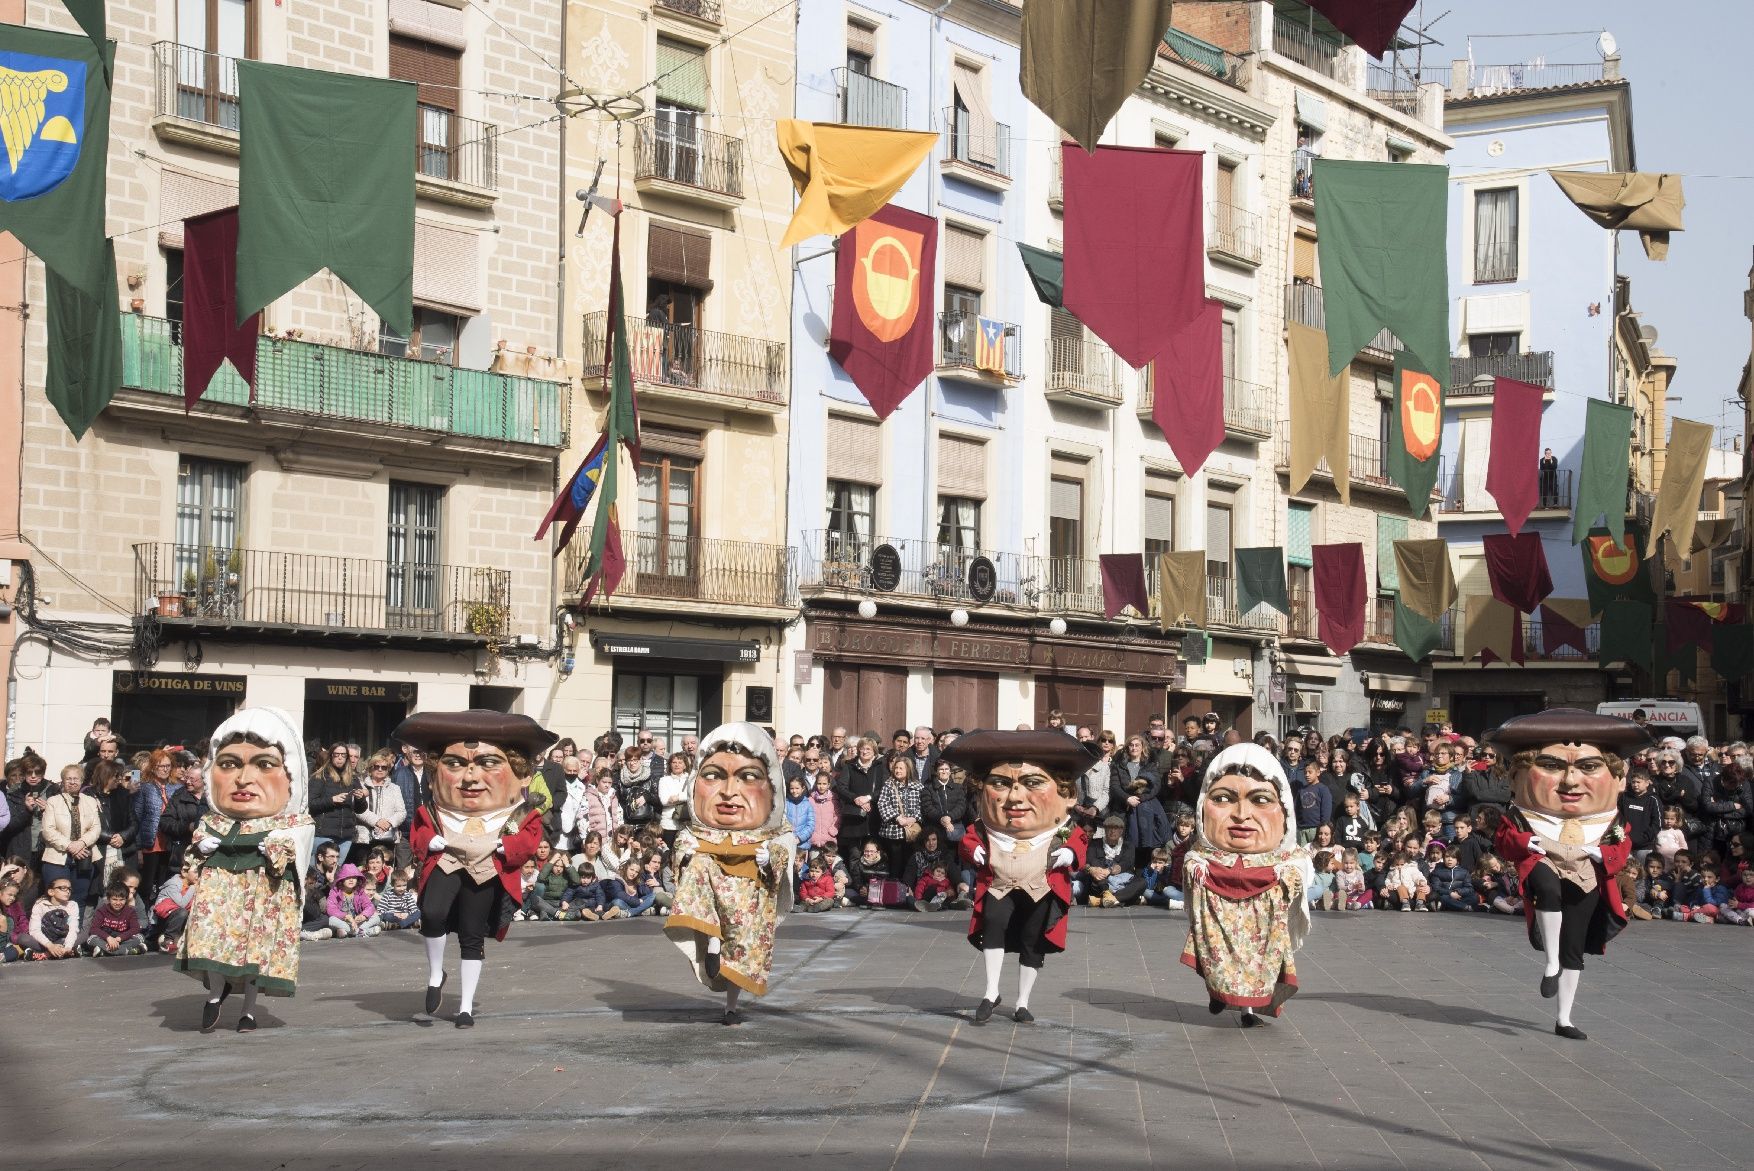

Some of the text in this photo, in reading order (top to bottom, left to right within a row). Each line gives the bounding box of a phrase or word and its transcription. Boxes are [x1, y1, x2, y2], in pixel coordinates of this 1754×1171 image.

[610, 645, 634, 653] ESTRELLA
[950, 640, 1012, 661] FERRER
[193, 680, 212, 691] DE
[214, 680, 245, 692] VINS
[327, 685, 386, 697] WINE BAR
